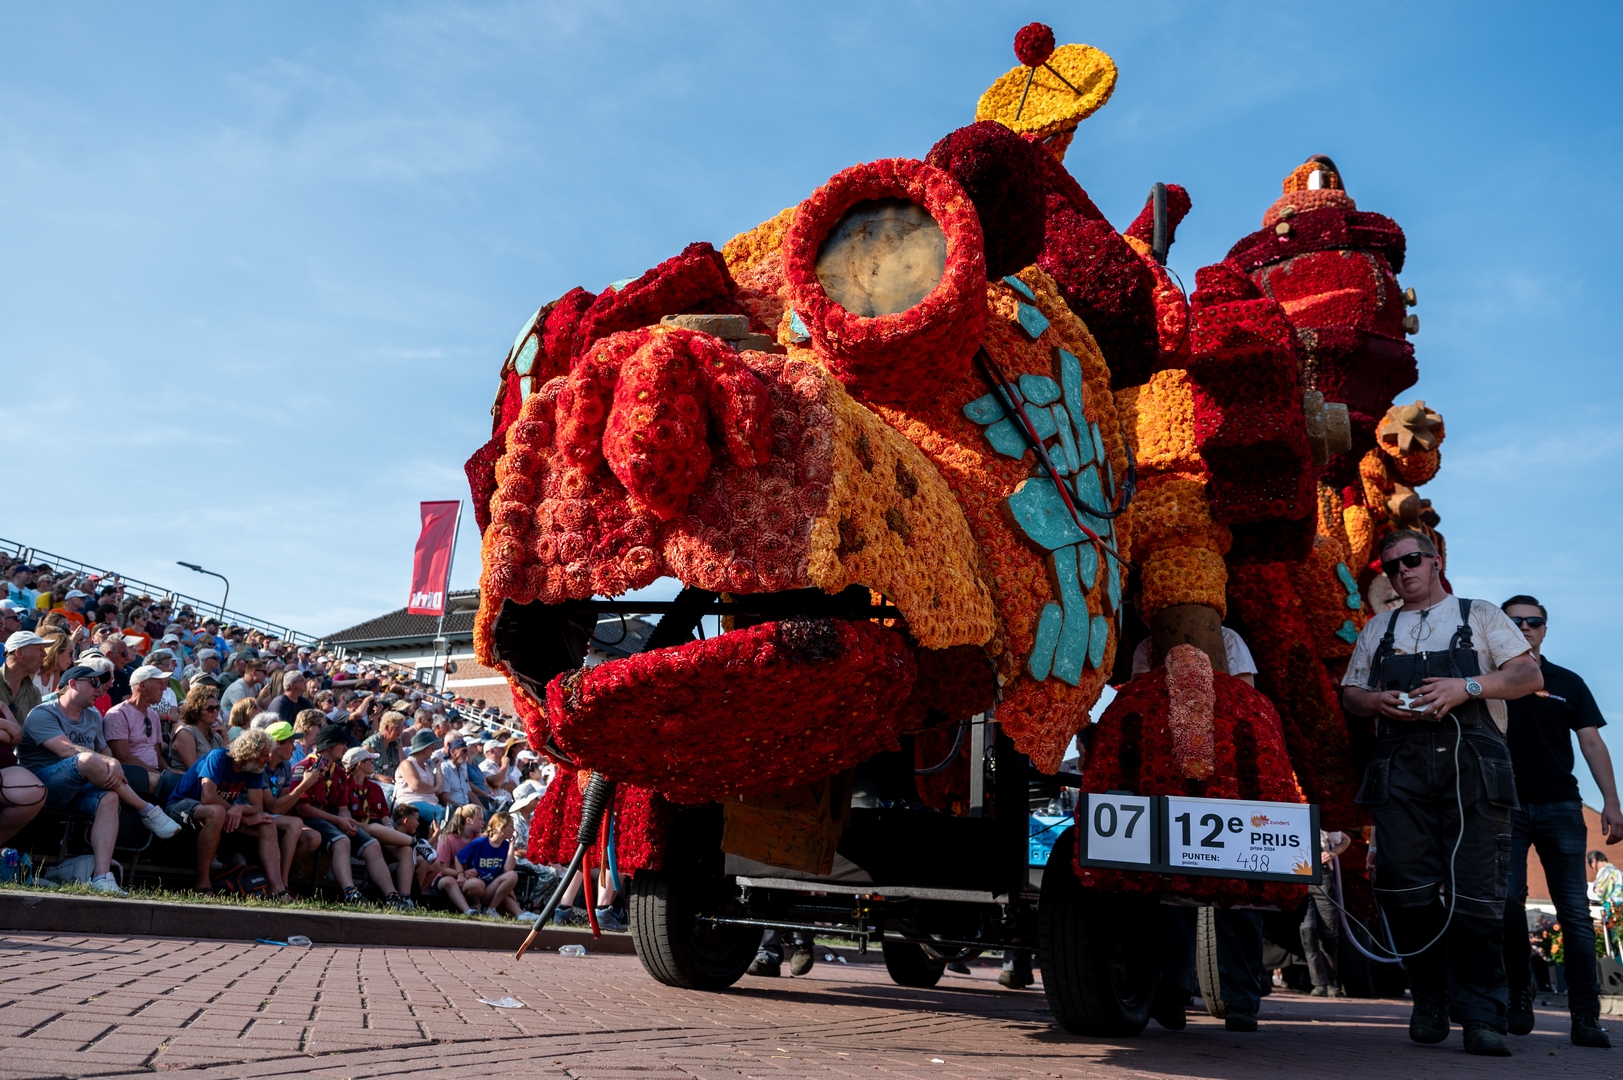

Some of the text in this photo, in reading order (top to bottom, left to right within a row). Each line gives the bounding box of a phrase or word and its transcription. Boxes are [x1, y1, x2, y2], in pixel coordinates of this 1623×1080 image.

[65, 731, 93, 744] Oliver
[1094, 802, 1145, 839] 07
[1174, 812, 1244, 849] 12e
[1251, 832, 1300, 847] PRIJS
[1182, 852, 1220, 862] PUNTEN:
[1236, 852, 1270, 873] 498
